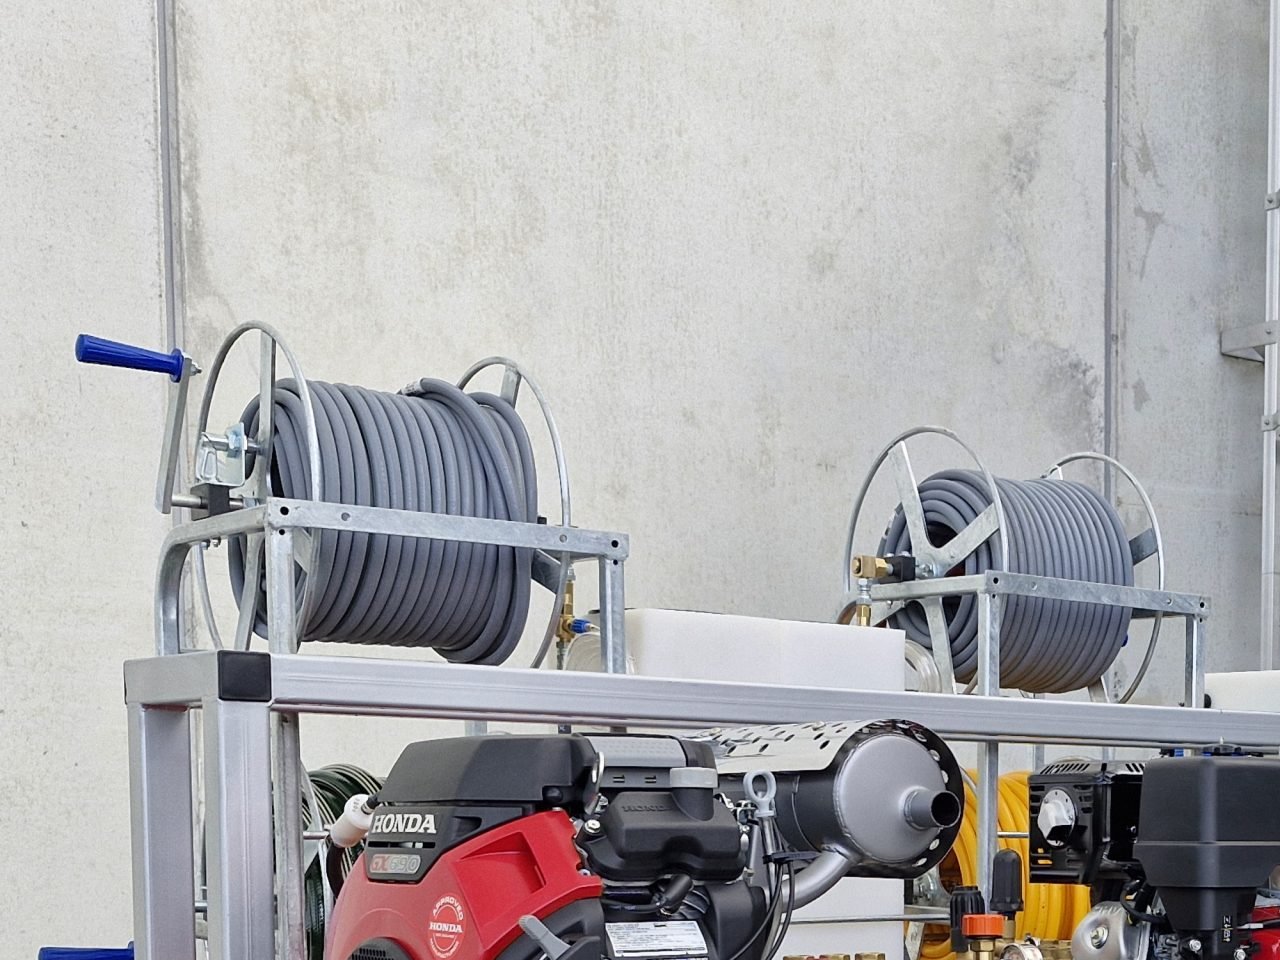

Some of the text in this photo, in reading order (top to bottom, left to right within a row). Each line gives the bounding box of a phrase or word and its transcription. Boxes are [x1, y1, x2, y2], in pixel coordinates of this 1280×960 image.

[371, 813, 437, 834] HONDA
[432, 896, 464, 920] APPROVED
[428, 921, 463, 933] HONDA
